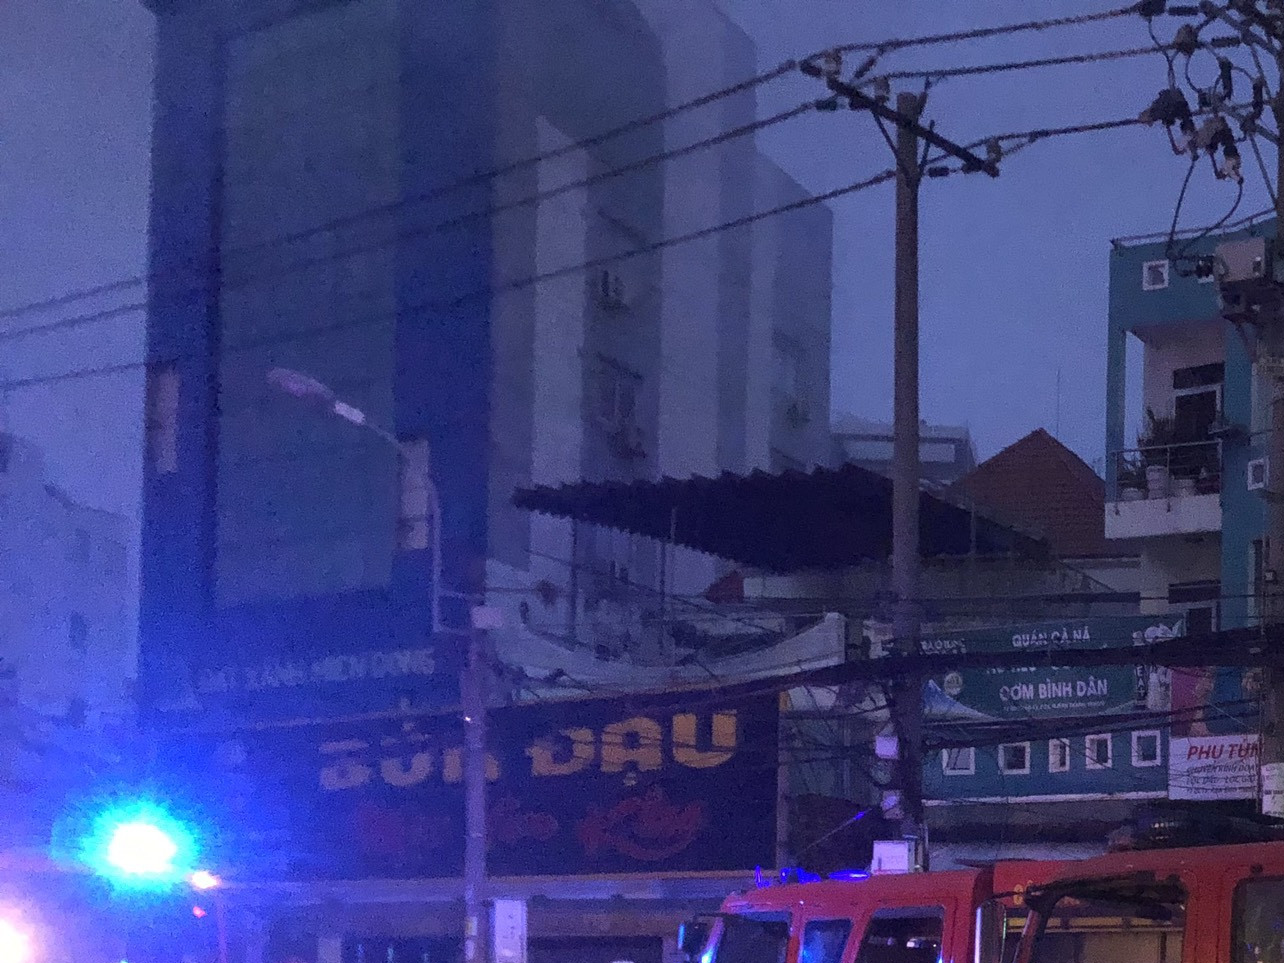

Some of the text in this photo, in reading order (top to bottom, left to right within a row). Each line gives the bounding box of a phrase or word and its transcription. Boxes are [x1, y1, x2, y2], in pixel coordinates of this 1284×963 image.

[999, 675, 1108, 702] CƠM BÌNH DÂN
